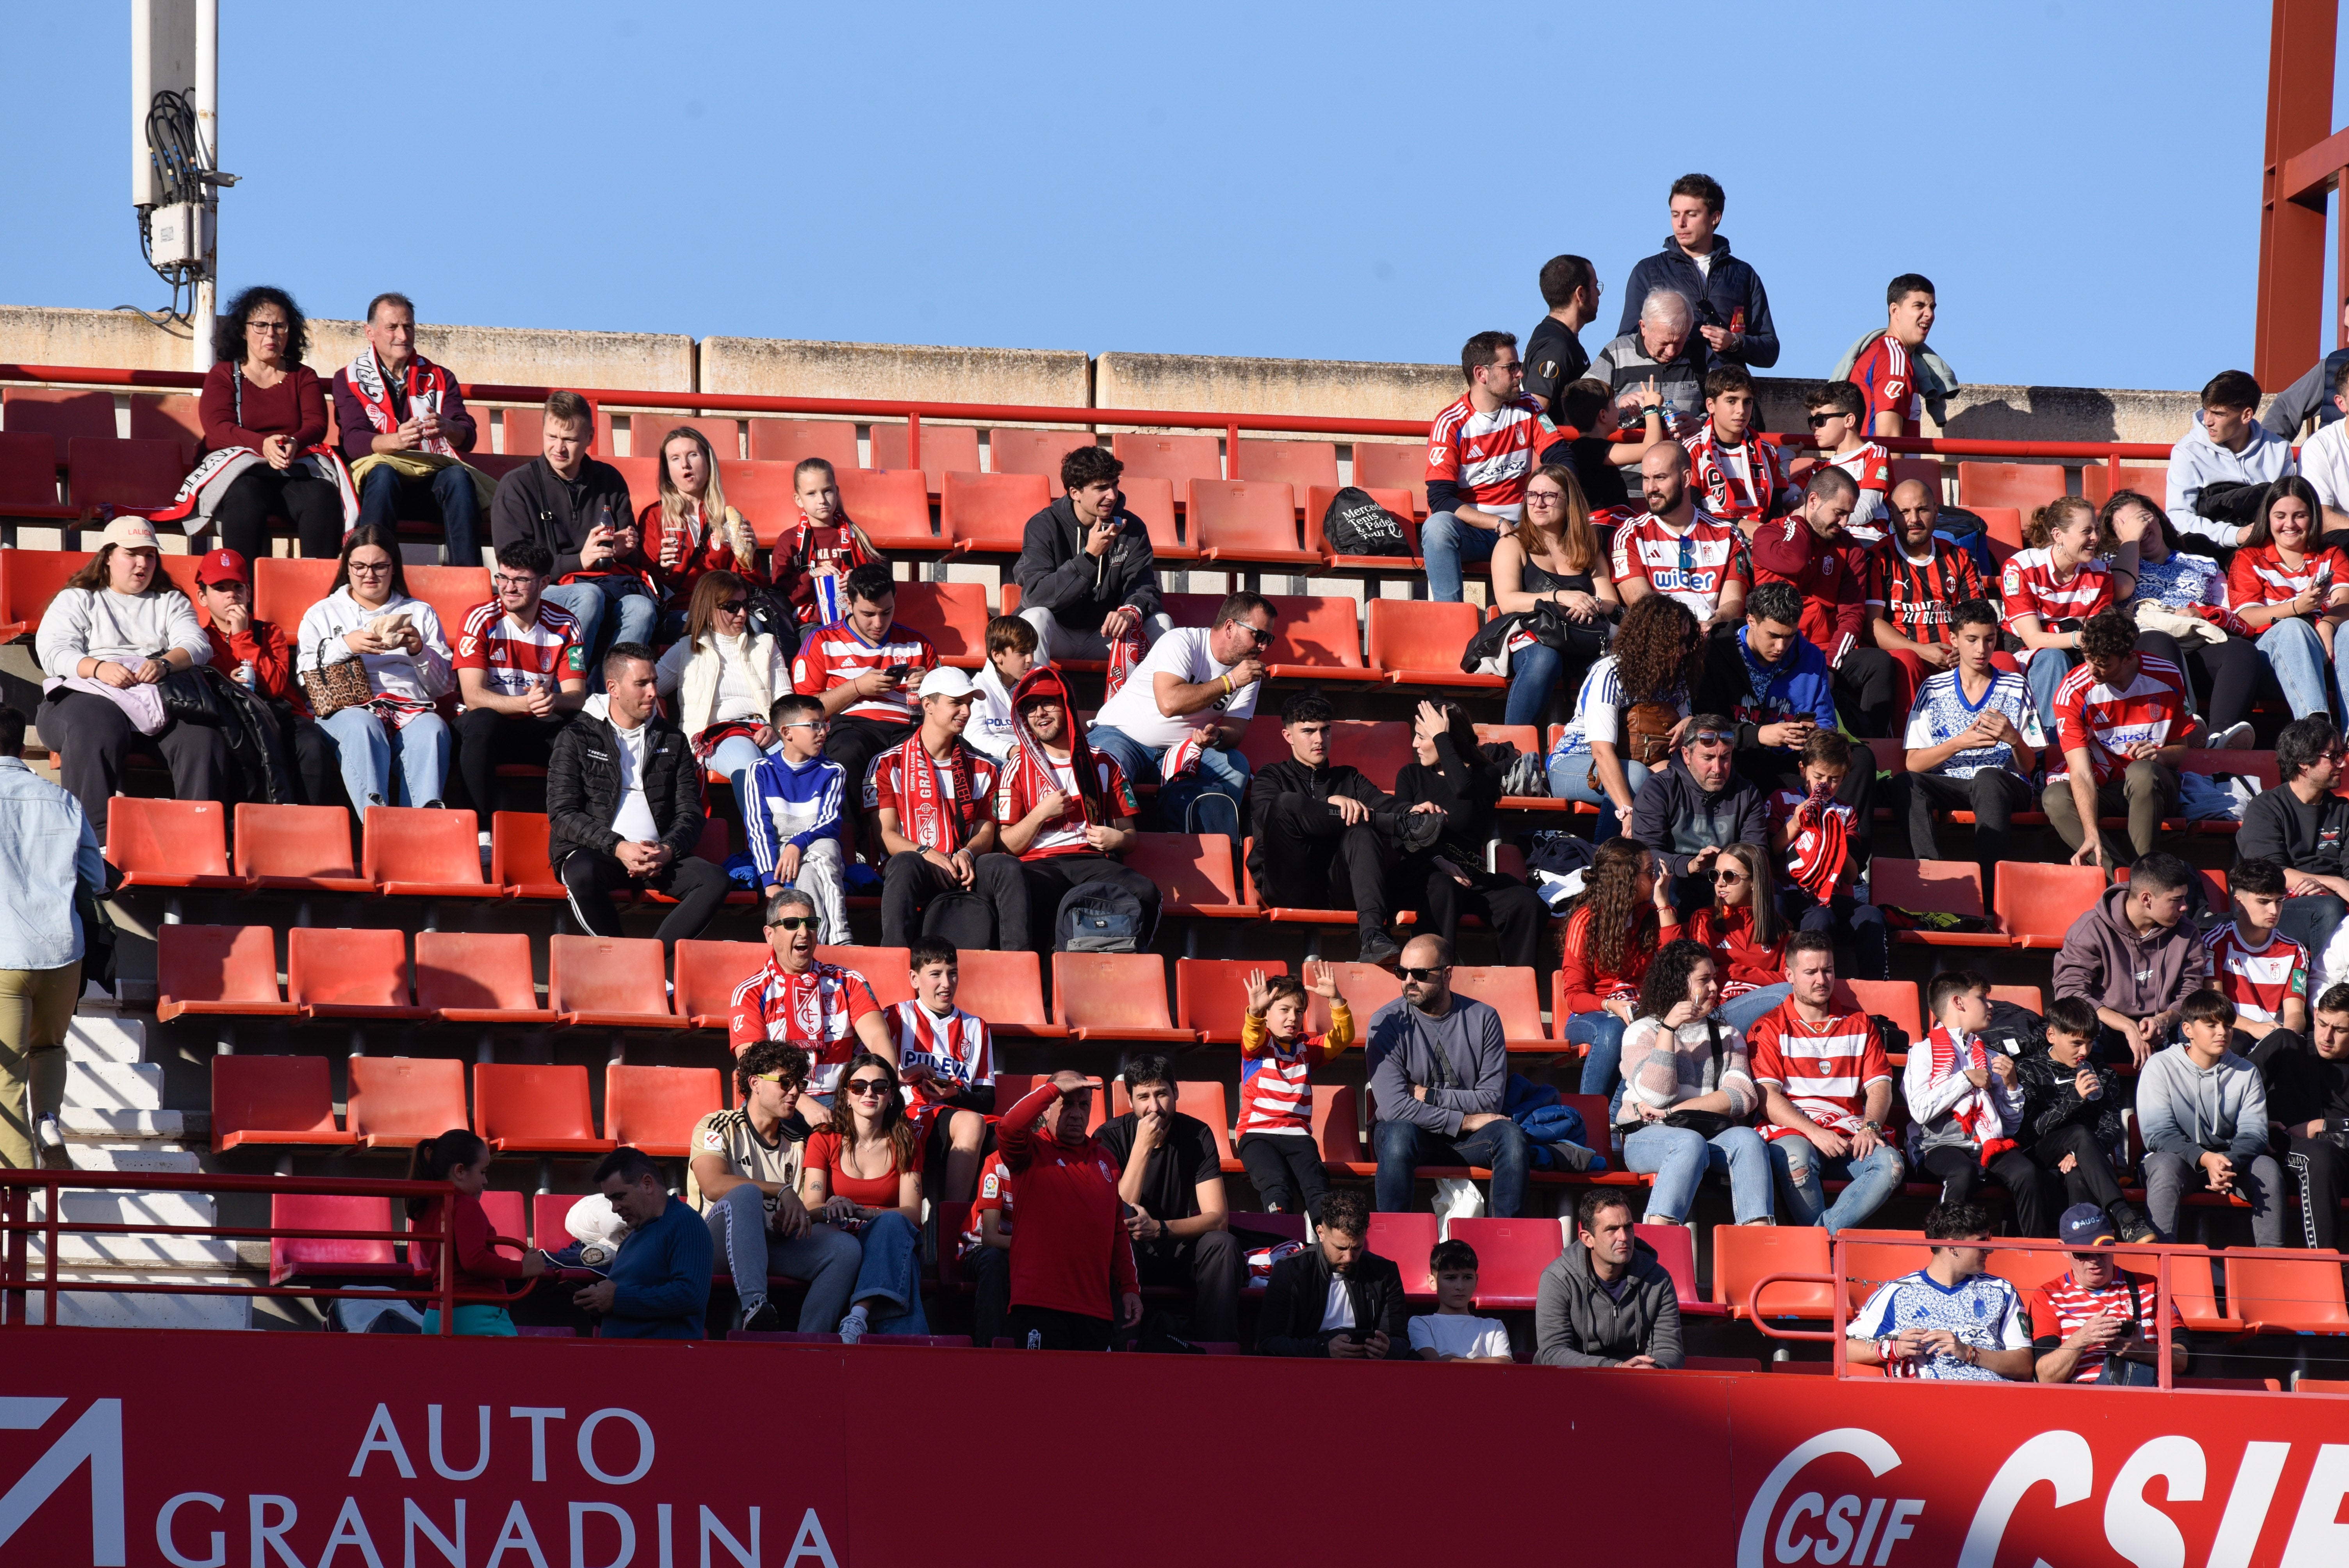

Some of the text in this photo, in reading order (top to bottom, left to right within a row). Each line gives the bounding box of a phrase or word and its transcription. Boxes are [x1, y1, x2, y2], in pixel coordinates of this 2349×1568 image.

[1348, 512, 1379, 527] Tenis
[1356, 517, 1392, 535] & Pádel
[128, 529, 152, 537] LALIGA
[1361, 529, 1385, 540] Tour
[1655, 570, 1715, 591] wiber
[1891, 599, 1952, 612] Emirate
[1902, 611, 1953, 624] FLY BETTER
[987, 718, 1014, 727] POLO
[587, 748, 608, 758] TREK
[1431, 1039, 1460, 1087] A
[2080, 1216, 2100, 1227] AUGC
[349, 1402, 655, 1485] AUTO
[155, 1492, 840, 1568] GRANADINA
[1775, 1491, 1925, 1567] CSIF
